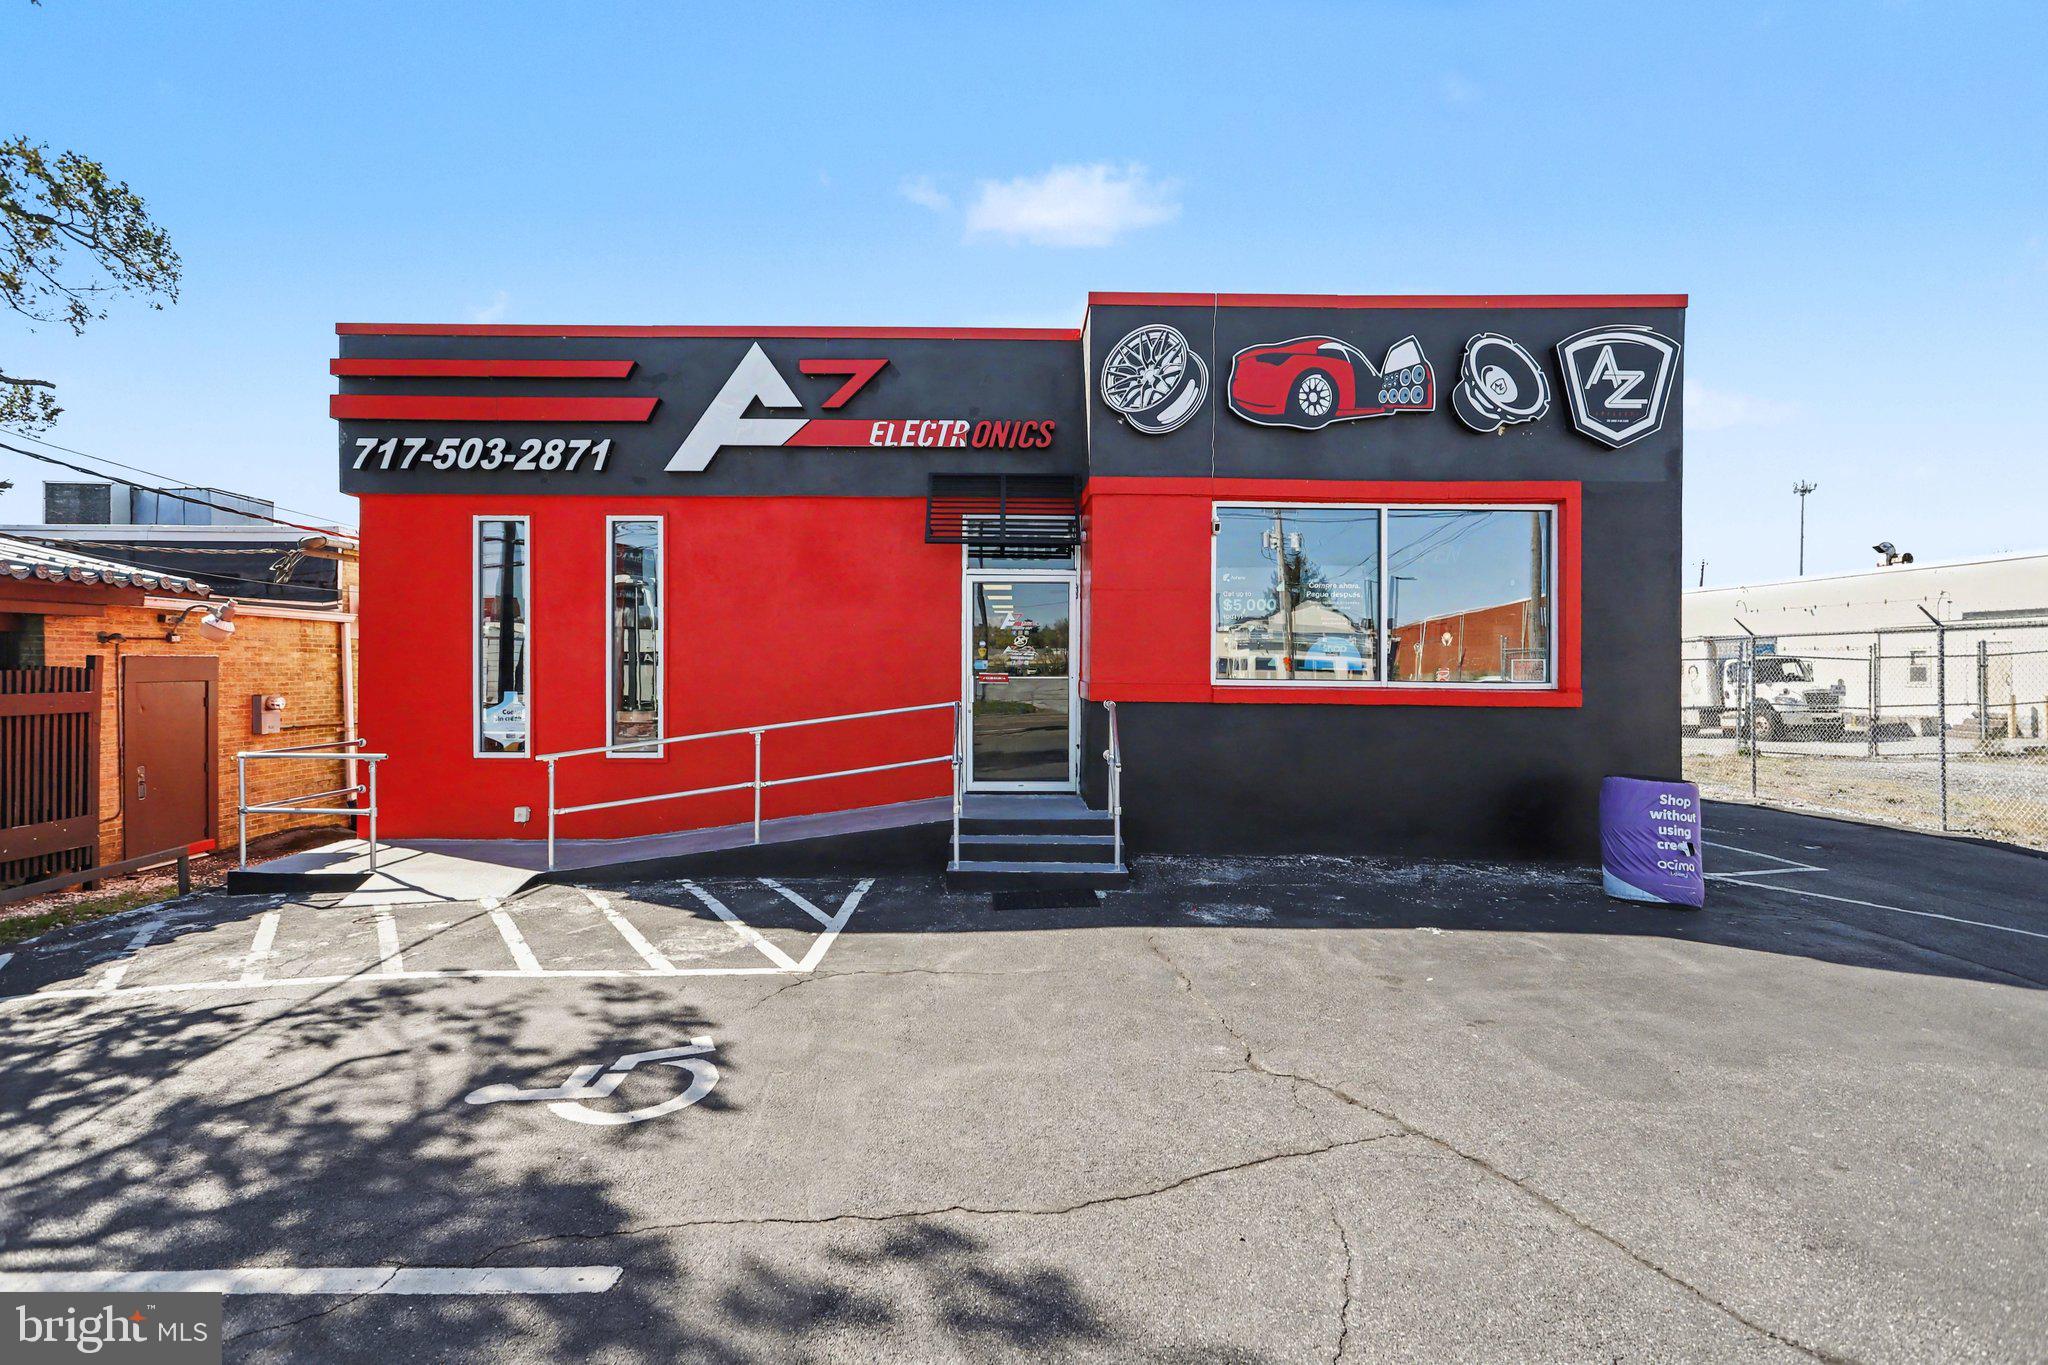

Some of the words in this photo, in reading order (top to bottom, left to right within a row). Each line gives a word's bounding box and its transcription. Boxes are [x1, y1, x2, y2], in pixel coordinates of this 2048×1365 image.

[1584, 345, 1648, 409] AZ
[869, 419, 1055, 449] ELECTRONICS
[352, 437, 611, 471] 717-503-2871
[1223, 598, 1277, 614] $5,000
[1660, 794, 1691, 809] Shop
[1649, 809, 1697, 823] without
[1658, 825, 1692, 839] using
[1657, 860, 1695, 872] acima
